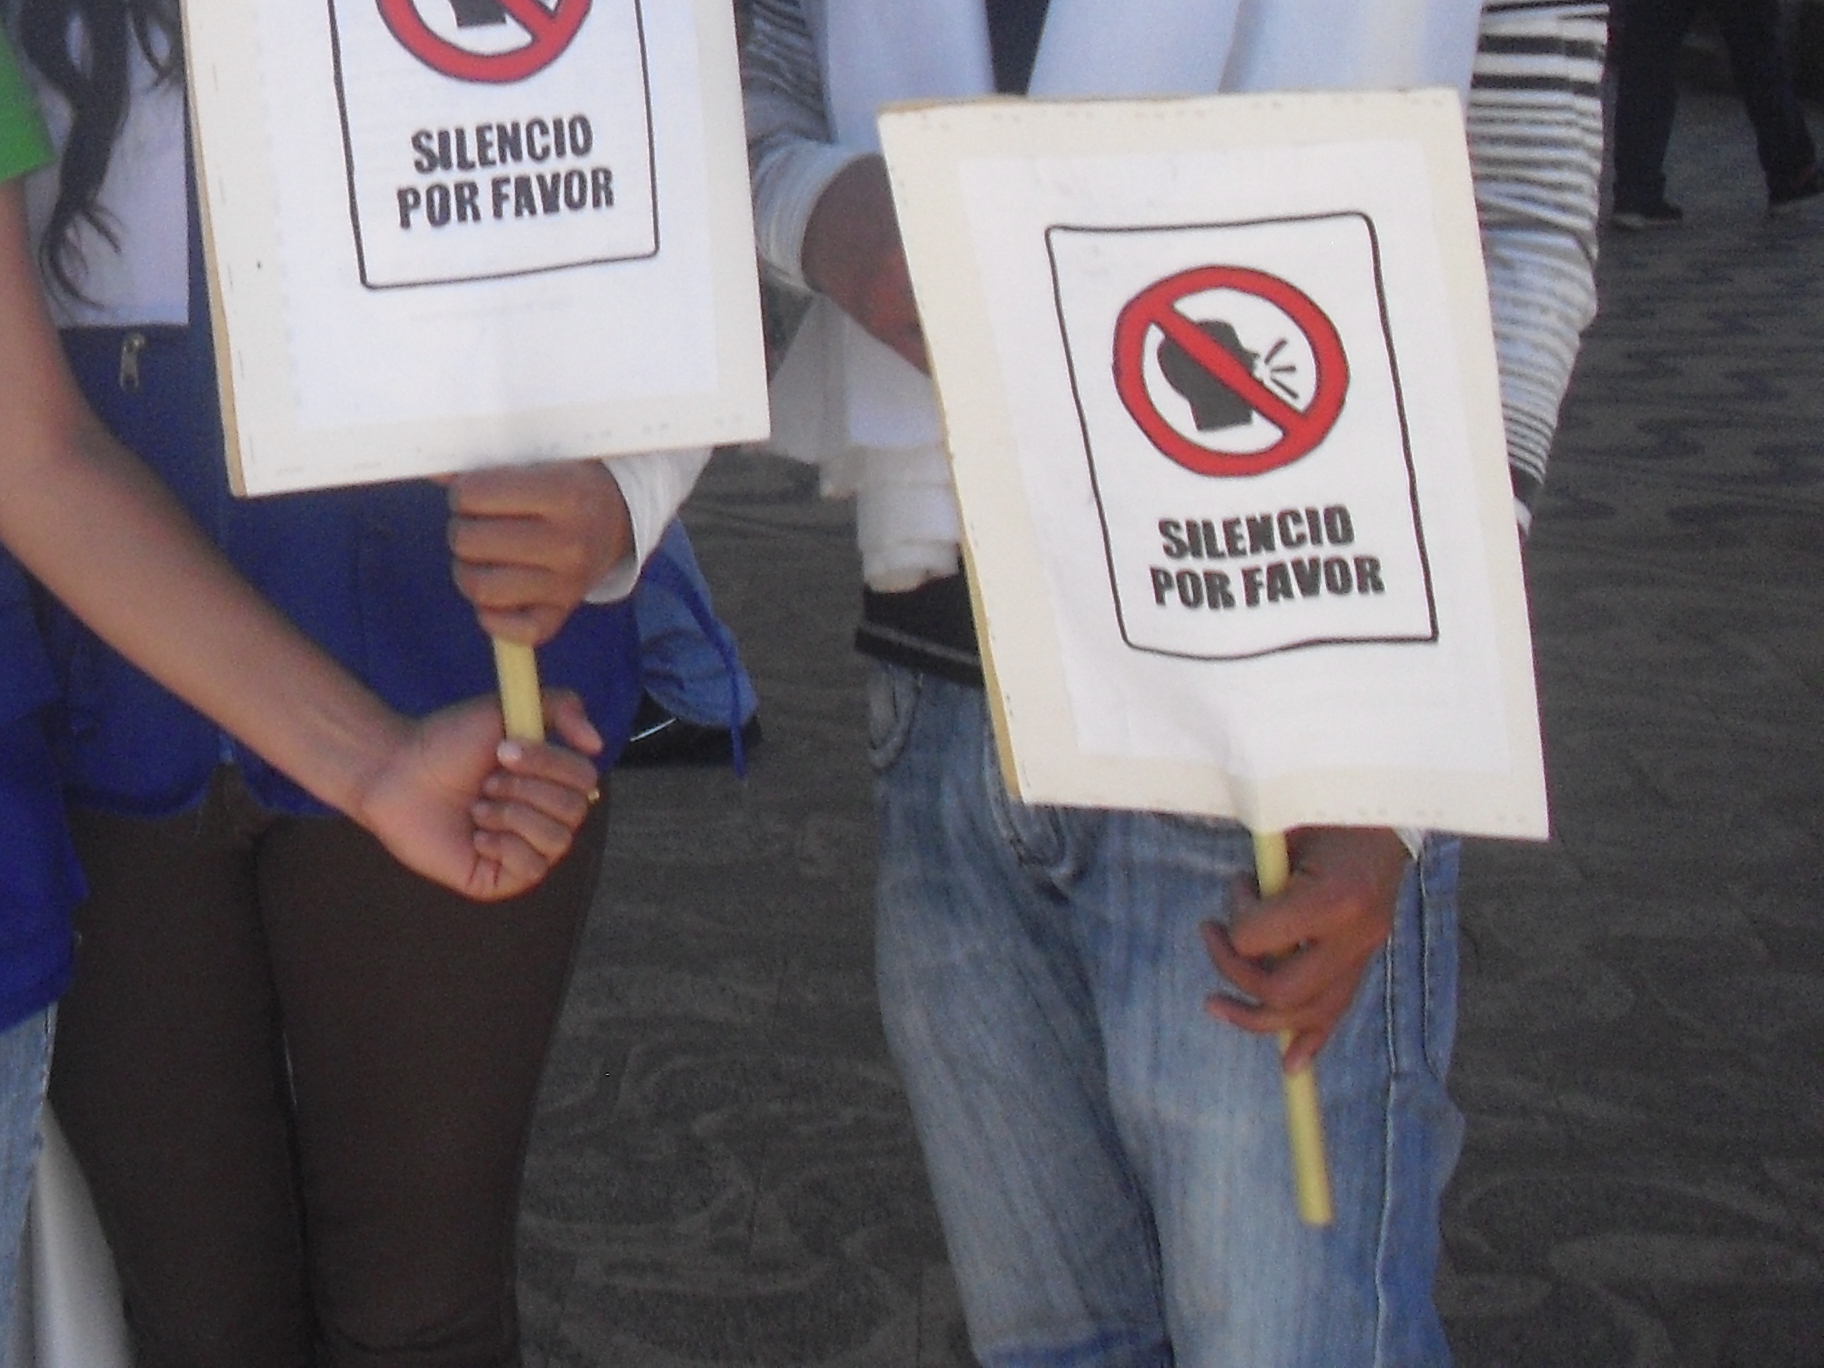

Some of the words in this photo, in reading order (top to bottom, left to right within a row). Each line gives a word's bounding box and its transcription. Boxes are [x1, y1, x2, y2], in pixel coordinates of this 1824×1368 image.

[411, 114, 593, 174] SILENCIO
[396, 180, 481, 229] POR
[491, 167, 614, 219] FAVOR
[1158, 504, 1355, 559] SILENCIO
[1150, 566, 1236, 610] POR
[1241, 554, 1385, 608] FAVOR
